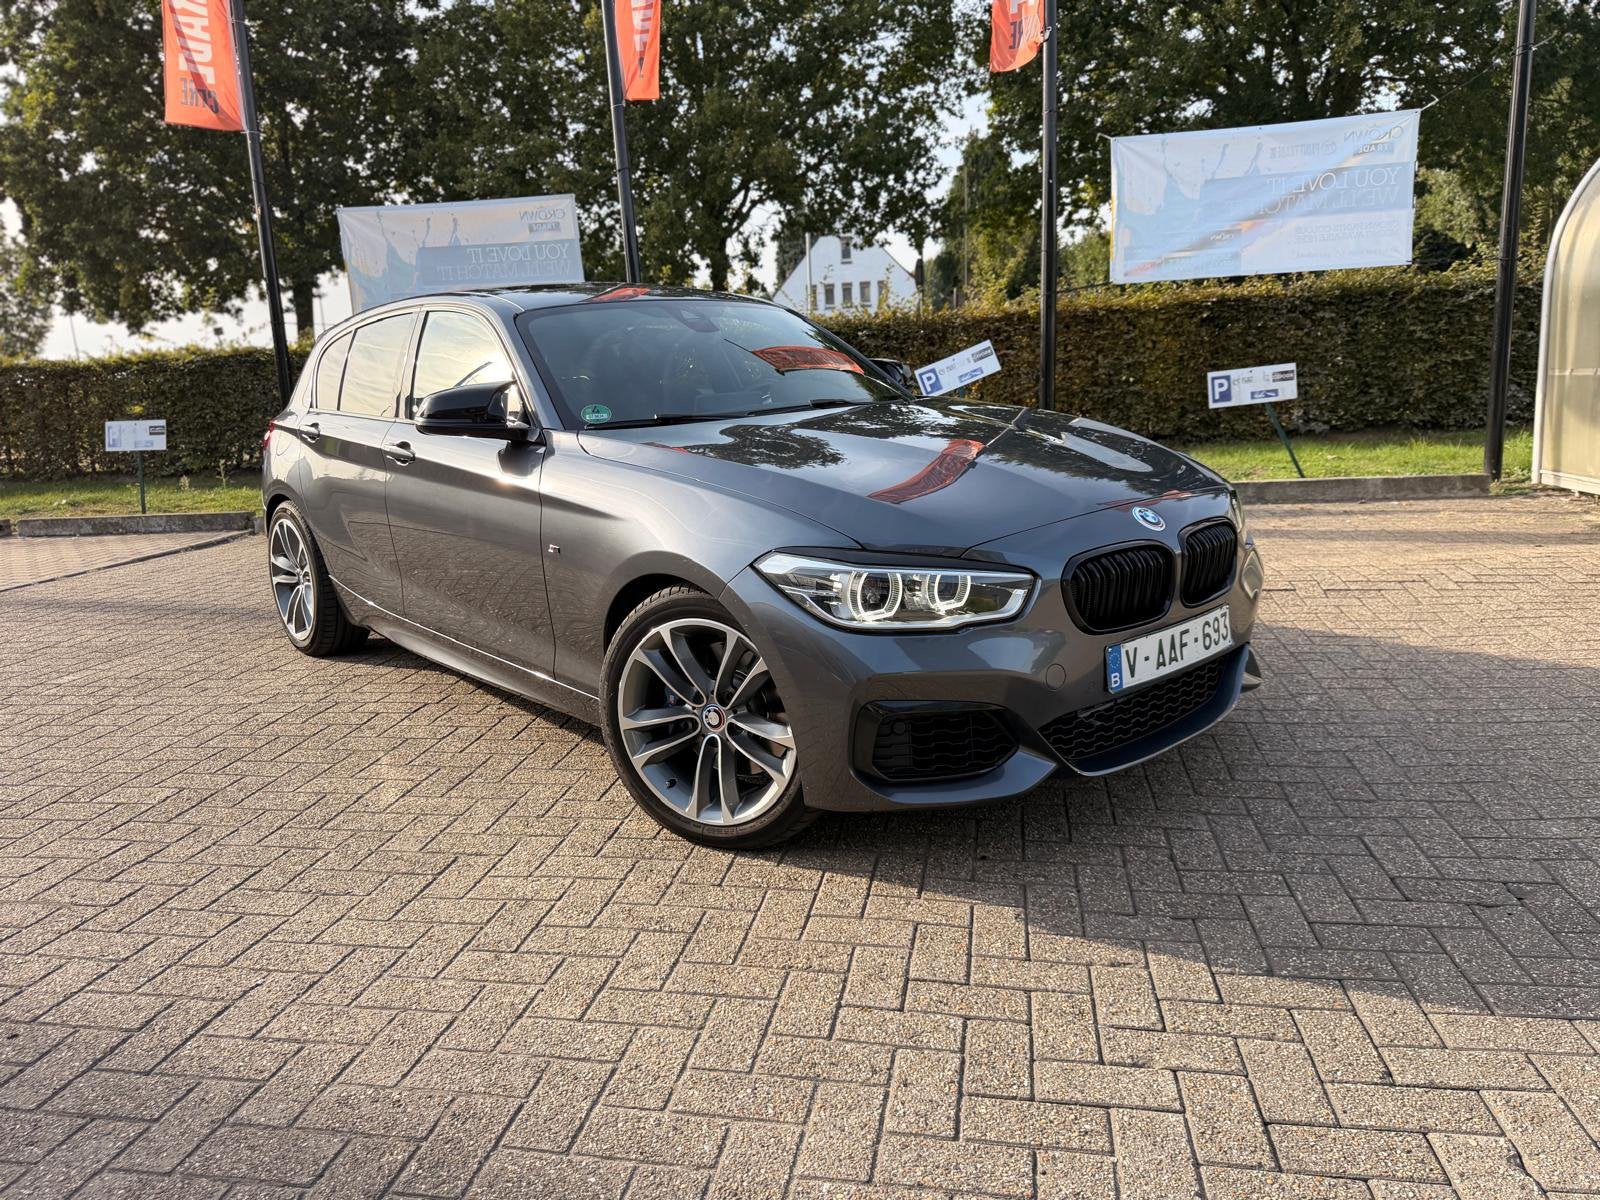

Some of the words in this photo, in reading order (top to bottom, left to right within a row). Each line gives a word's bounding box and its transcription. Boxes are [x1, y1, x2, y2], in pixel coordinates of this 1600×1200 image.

[921, 372, 936, 392] P
[1213, 378, 1229, 401] P
[1125, 611, 1229, 679] V-AAF-693
[1111, 672, 1121, 688] B
